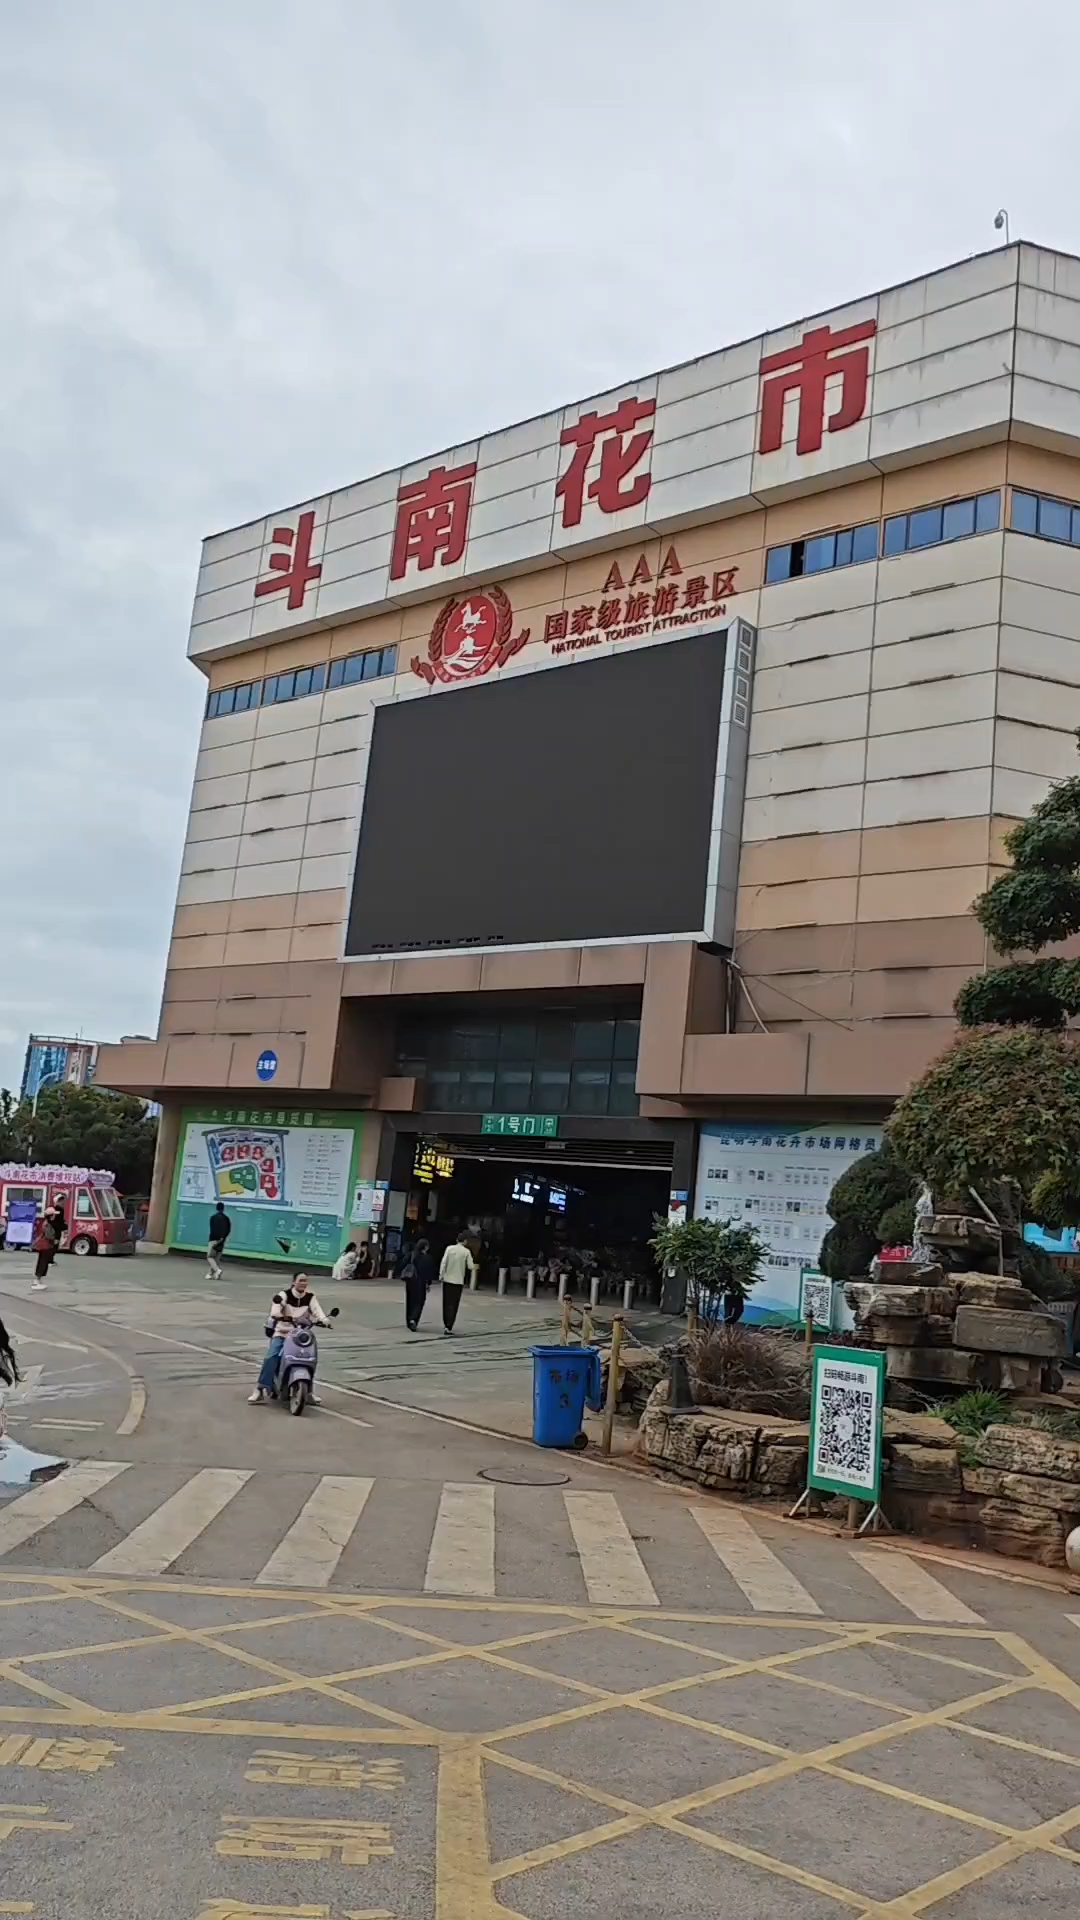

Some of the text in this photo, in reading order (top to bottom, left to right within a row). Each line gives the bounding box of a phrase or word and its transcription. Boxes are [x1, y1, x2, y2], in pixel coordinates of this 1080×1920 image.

[255, 319, 876, 610] 斗南花市
[601, 543, 685, 593] AAA
[543, 565, 740, 644] 国家级旅游景区
[551, 603, 727, 656] NATIONAL TOURIST ATTRACTION
[497, 1116, 536, 1135] 1号门
